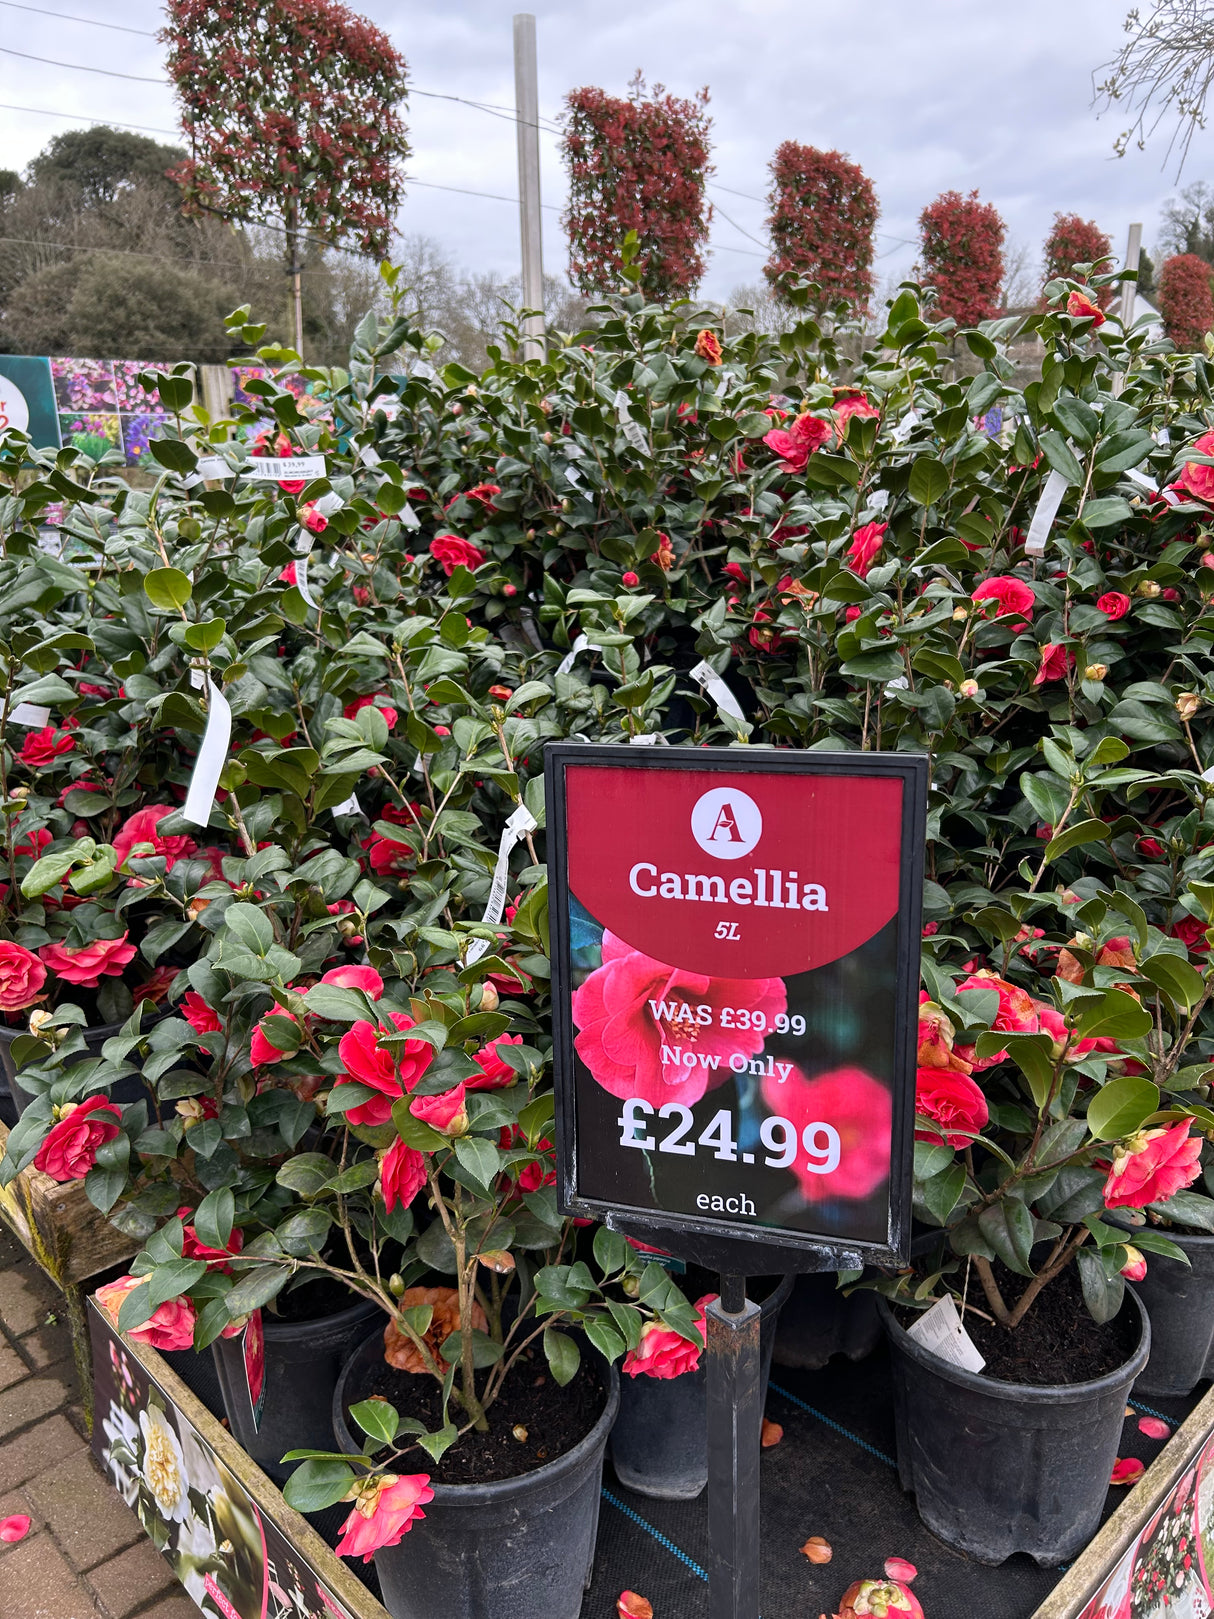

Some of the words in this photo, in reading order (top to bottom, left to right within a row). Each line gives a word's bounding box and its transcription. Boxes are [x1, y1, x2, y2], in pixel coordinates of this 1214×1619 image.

[706, 803, 746, 843] A
[629, 863, 829, 911] Camellia
[713, 921, 742, 941] 5L
[648, 999, 713, 1027] WAS
[719, 1008, 807, 1037] £39.99
[661, 1045, 722, 1070] Now
[729, 1055, 793, 1083] Only
[617, 1098, 841, 1175] £24.99
[696, 1190, 758, 1217] each
[204, 1576, 229, 1613] perfect
